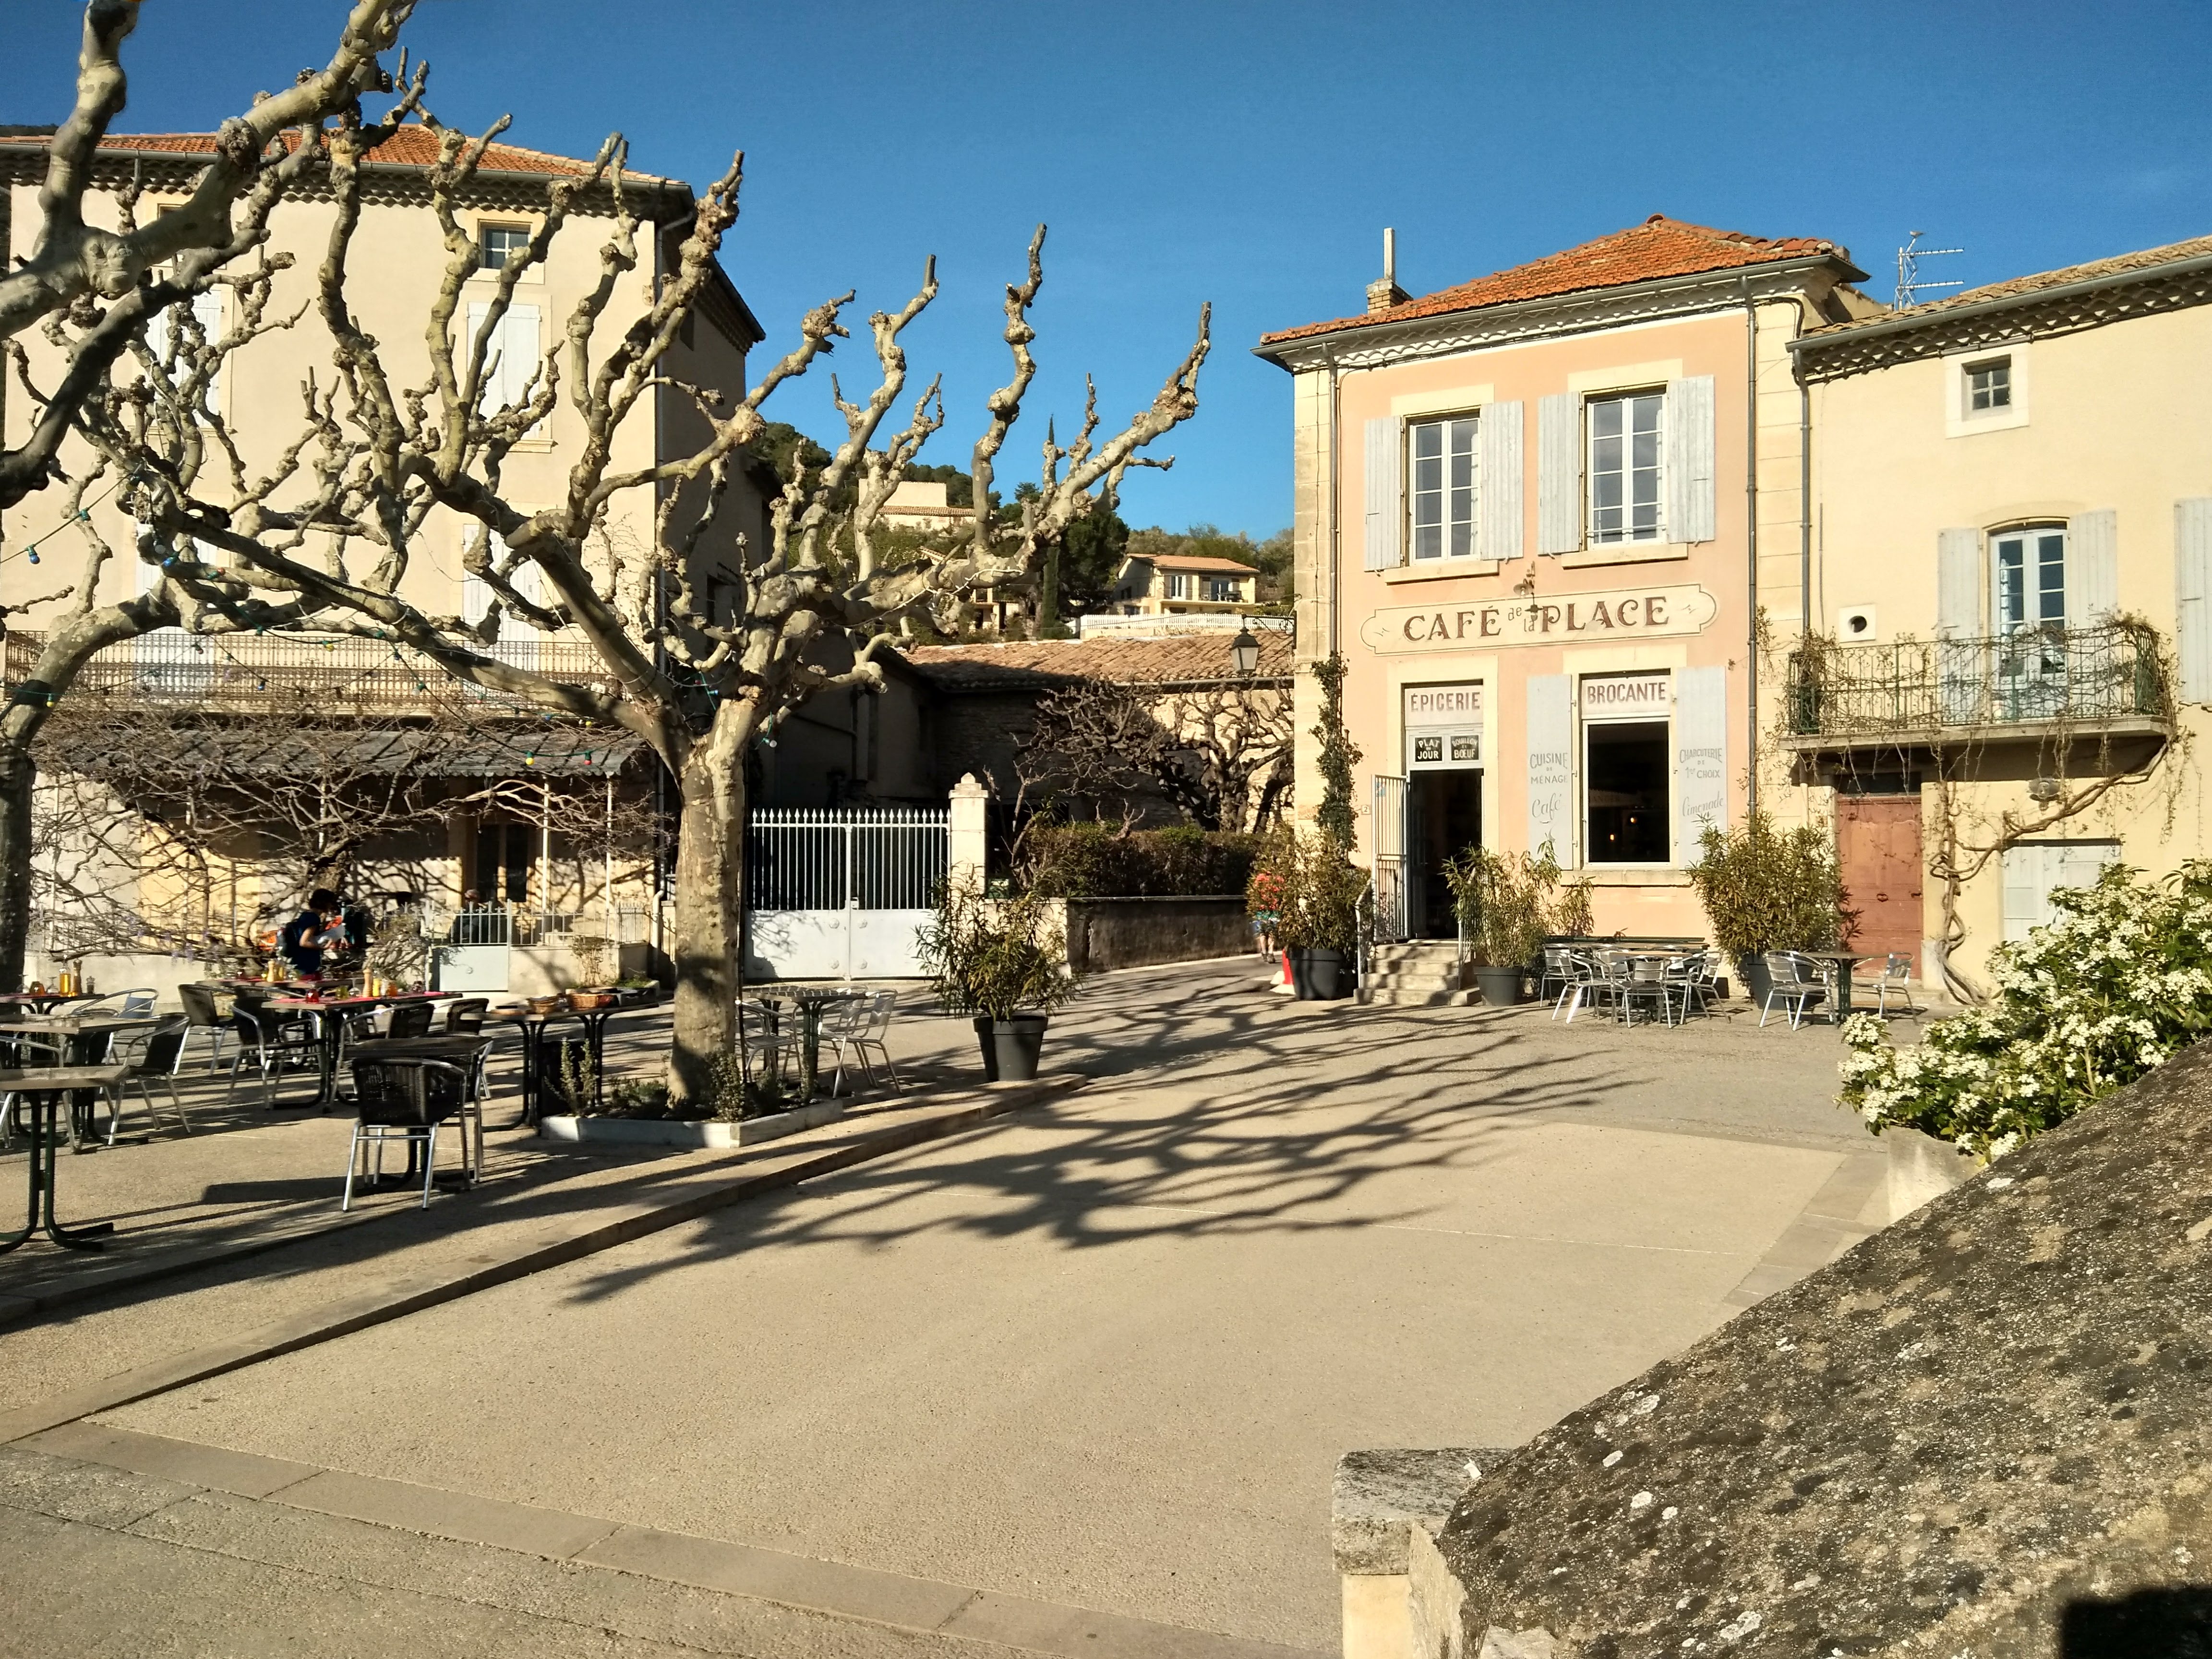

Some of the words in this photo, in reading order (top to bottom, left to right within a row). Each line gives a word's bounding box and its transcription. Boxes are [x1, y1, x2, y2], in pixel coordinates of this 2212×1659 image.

[1404, 605, 1502, 642] CAFÉ
[1508, 607, 1522, 621] de
[1524, 618, 1535, 632] la
[1541, 596, 1670, 632] PLACE
[1587, 682, 1666, 704] BROCANTE
[1410, 692, 1480, 712] ÉPICERIE
[1418, 739, 1440, 748] PLAT
[1452, 737, 1478, 747] BOUILLON
[1417, 751, 1439, 759] JOUR
[1530, 752, 1568, 769] CUISINE
[1680, 748, 1722, 763] CHARCUTERIE
[1696, 769, 1720, 779] CHOIX
[1532, 793, 1562, 820] Café
[1682, 791, 1723, 817] Limonade
